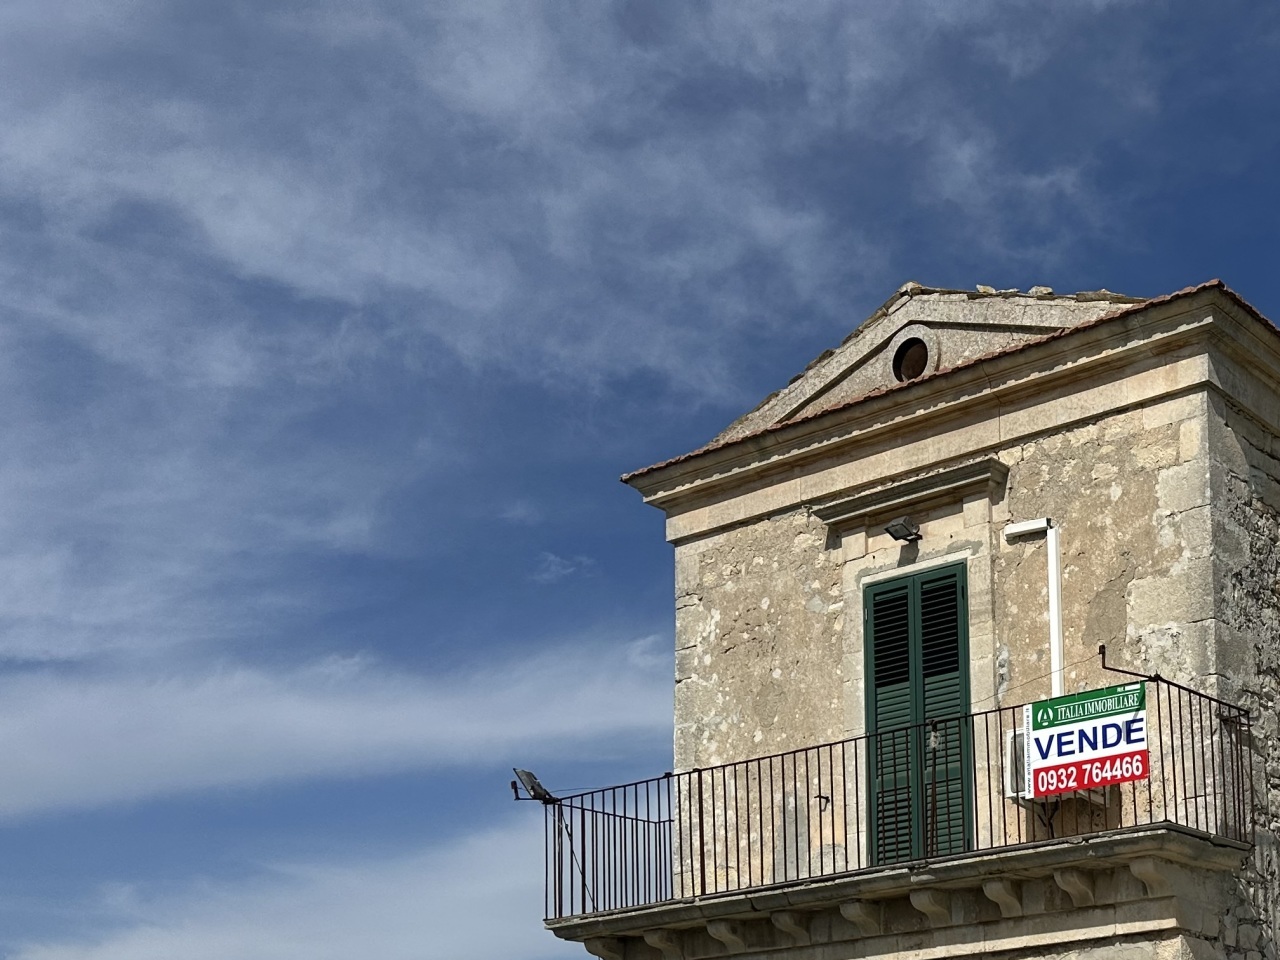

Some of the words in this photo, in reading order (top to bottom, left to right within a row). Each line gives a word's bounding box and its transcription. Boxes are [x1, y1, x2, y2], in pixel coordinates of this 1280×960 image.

[1058, 706, 1083, 720] ITALIA
[1085, 693, 1139, 715] IMMOBILIARE
[1034, 717, 1145, 760] VENDE
[1038, 767, 1077, 792] 0932
[1082, 754, 1143, 785] 764466
